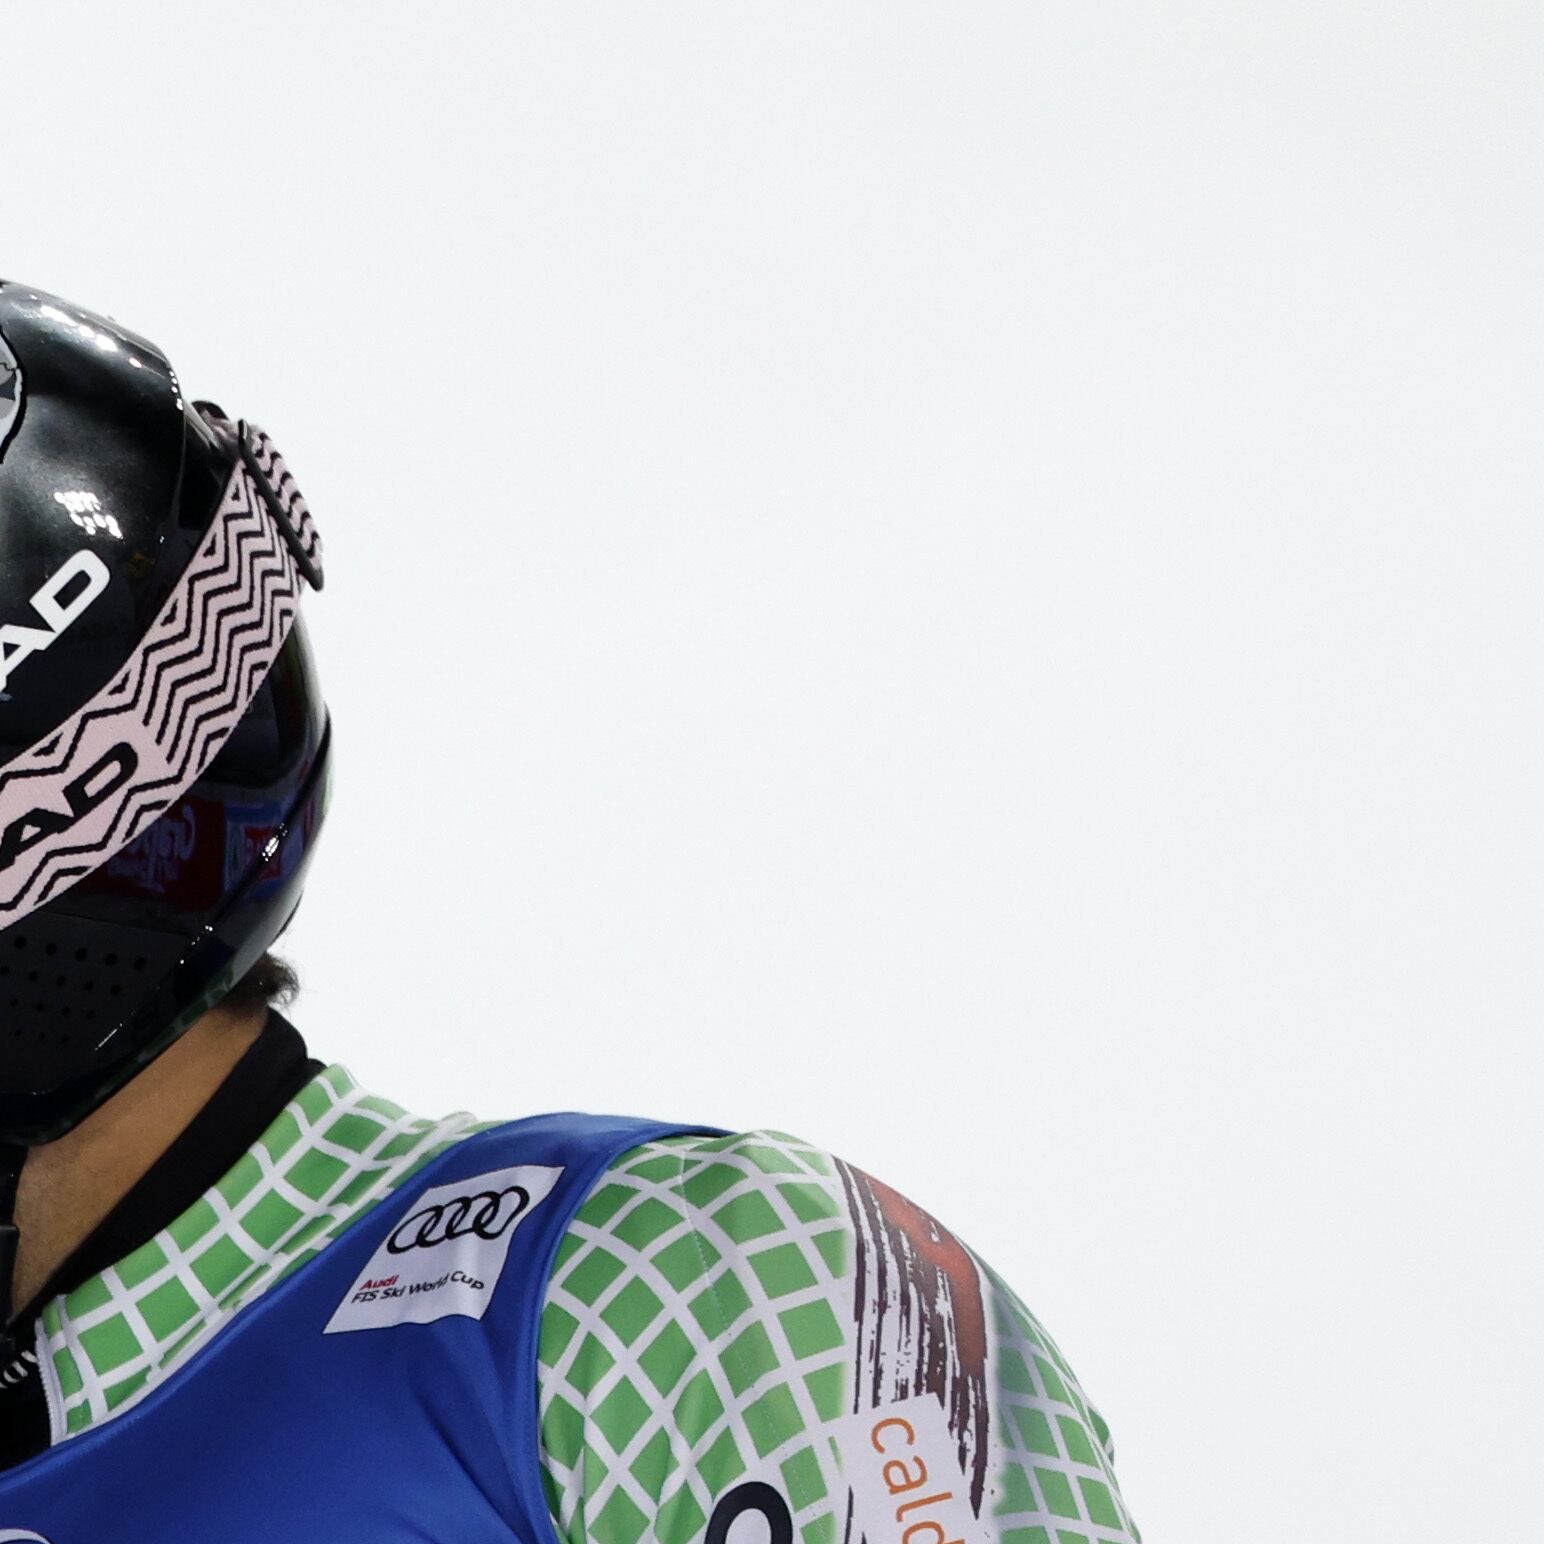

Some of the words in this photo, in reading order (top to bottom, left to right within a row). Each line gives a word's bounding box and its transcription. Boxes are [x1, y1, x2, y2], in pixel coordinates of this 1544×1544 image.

[350, 1289, 377, 1304] FIS
[379, 1286, 407, 1301] Ski
[408, 1272, 450, 1296] World
[449, 1270, 486, 1291] Cup
[360, 1275, 400, 1290] Audi
